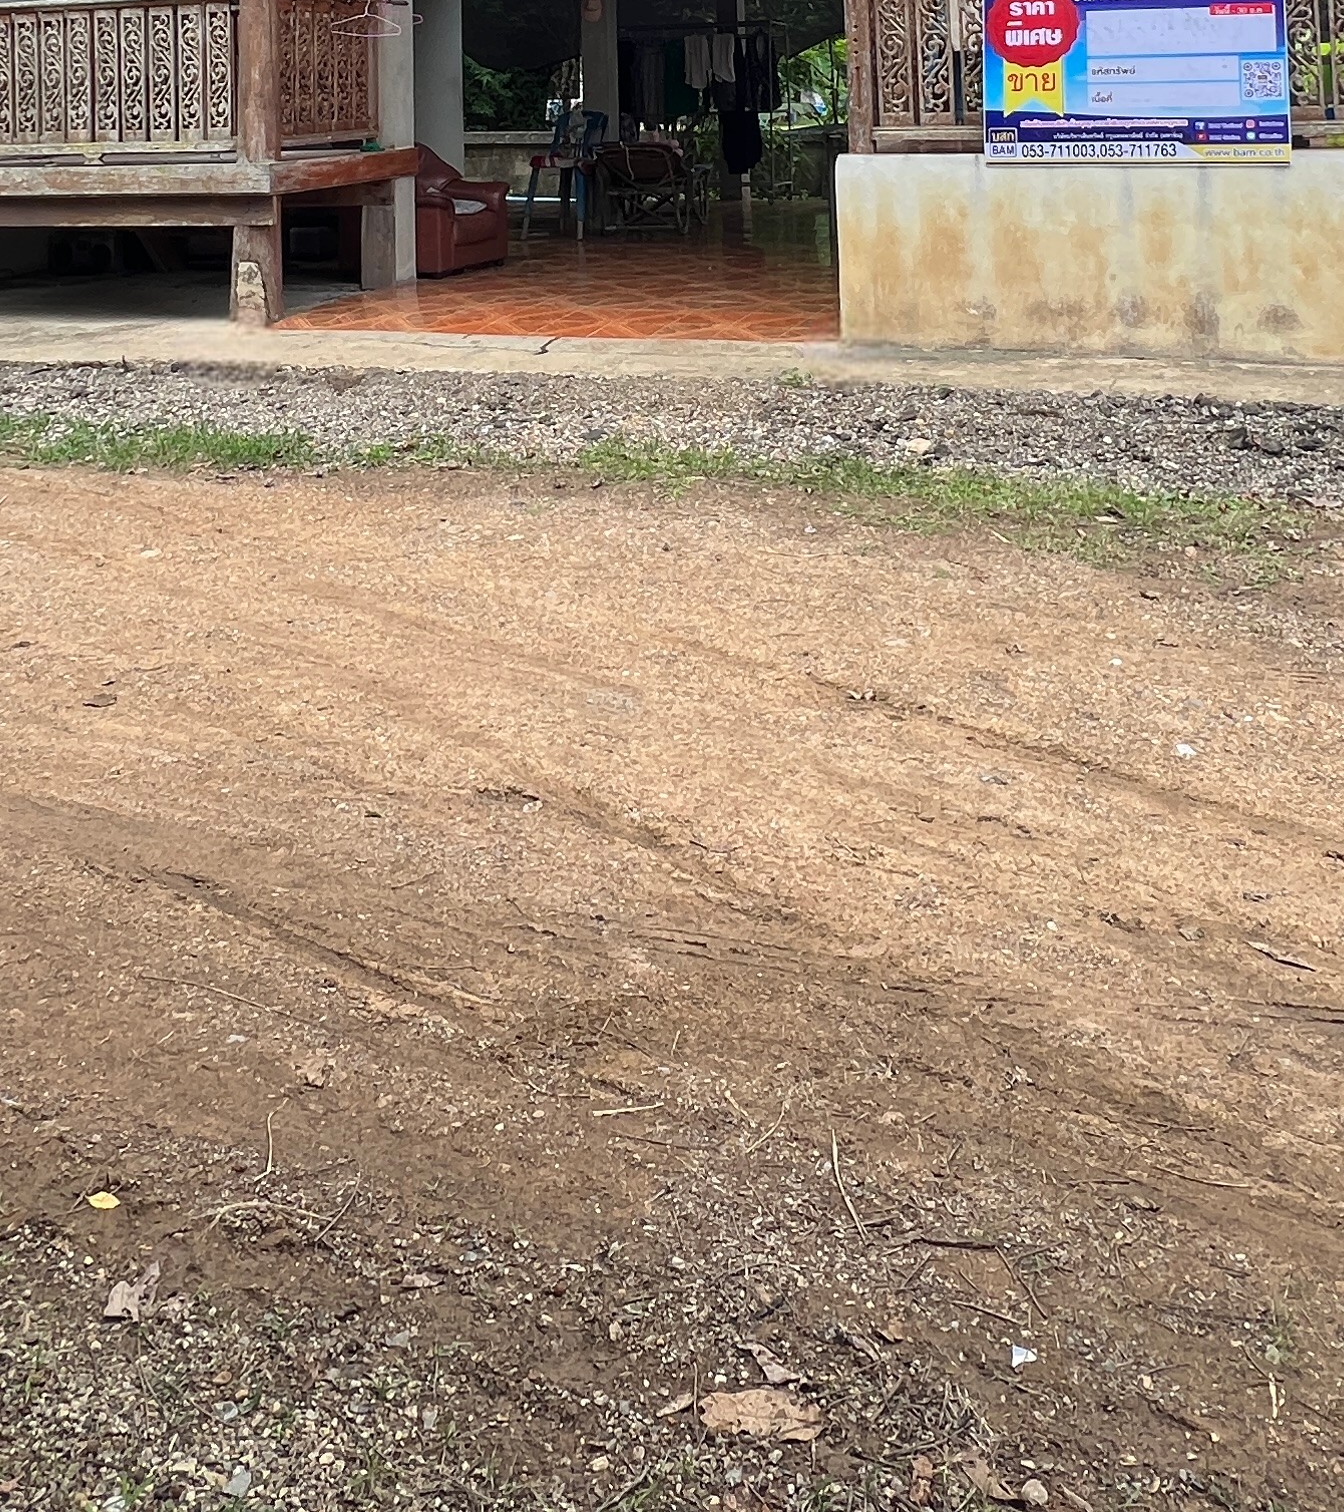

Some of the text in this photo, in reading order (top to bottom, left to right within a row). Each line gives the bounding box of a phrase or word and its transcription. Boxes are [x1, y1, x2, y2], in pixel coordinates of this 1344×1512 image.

[1009, 0, 1055, 17] ราคา
[1004, 20, 1063, 47] พิเศษ
[1007, 72, 1057, 92] ขาย
[991, 130, 1015, 143] บสก
[991, 144, 1015, 156] BAM
[1021, 143, 1177, 159] 053-711003,053-711763
[1205, 147, 1285, 157] www.bam.co.th
